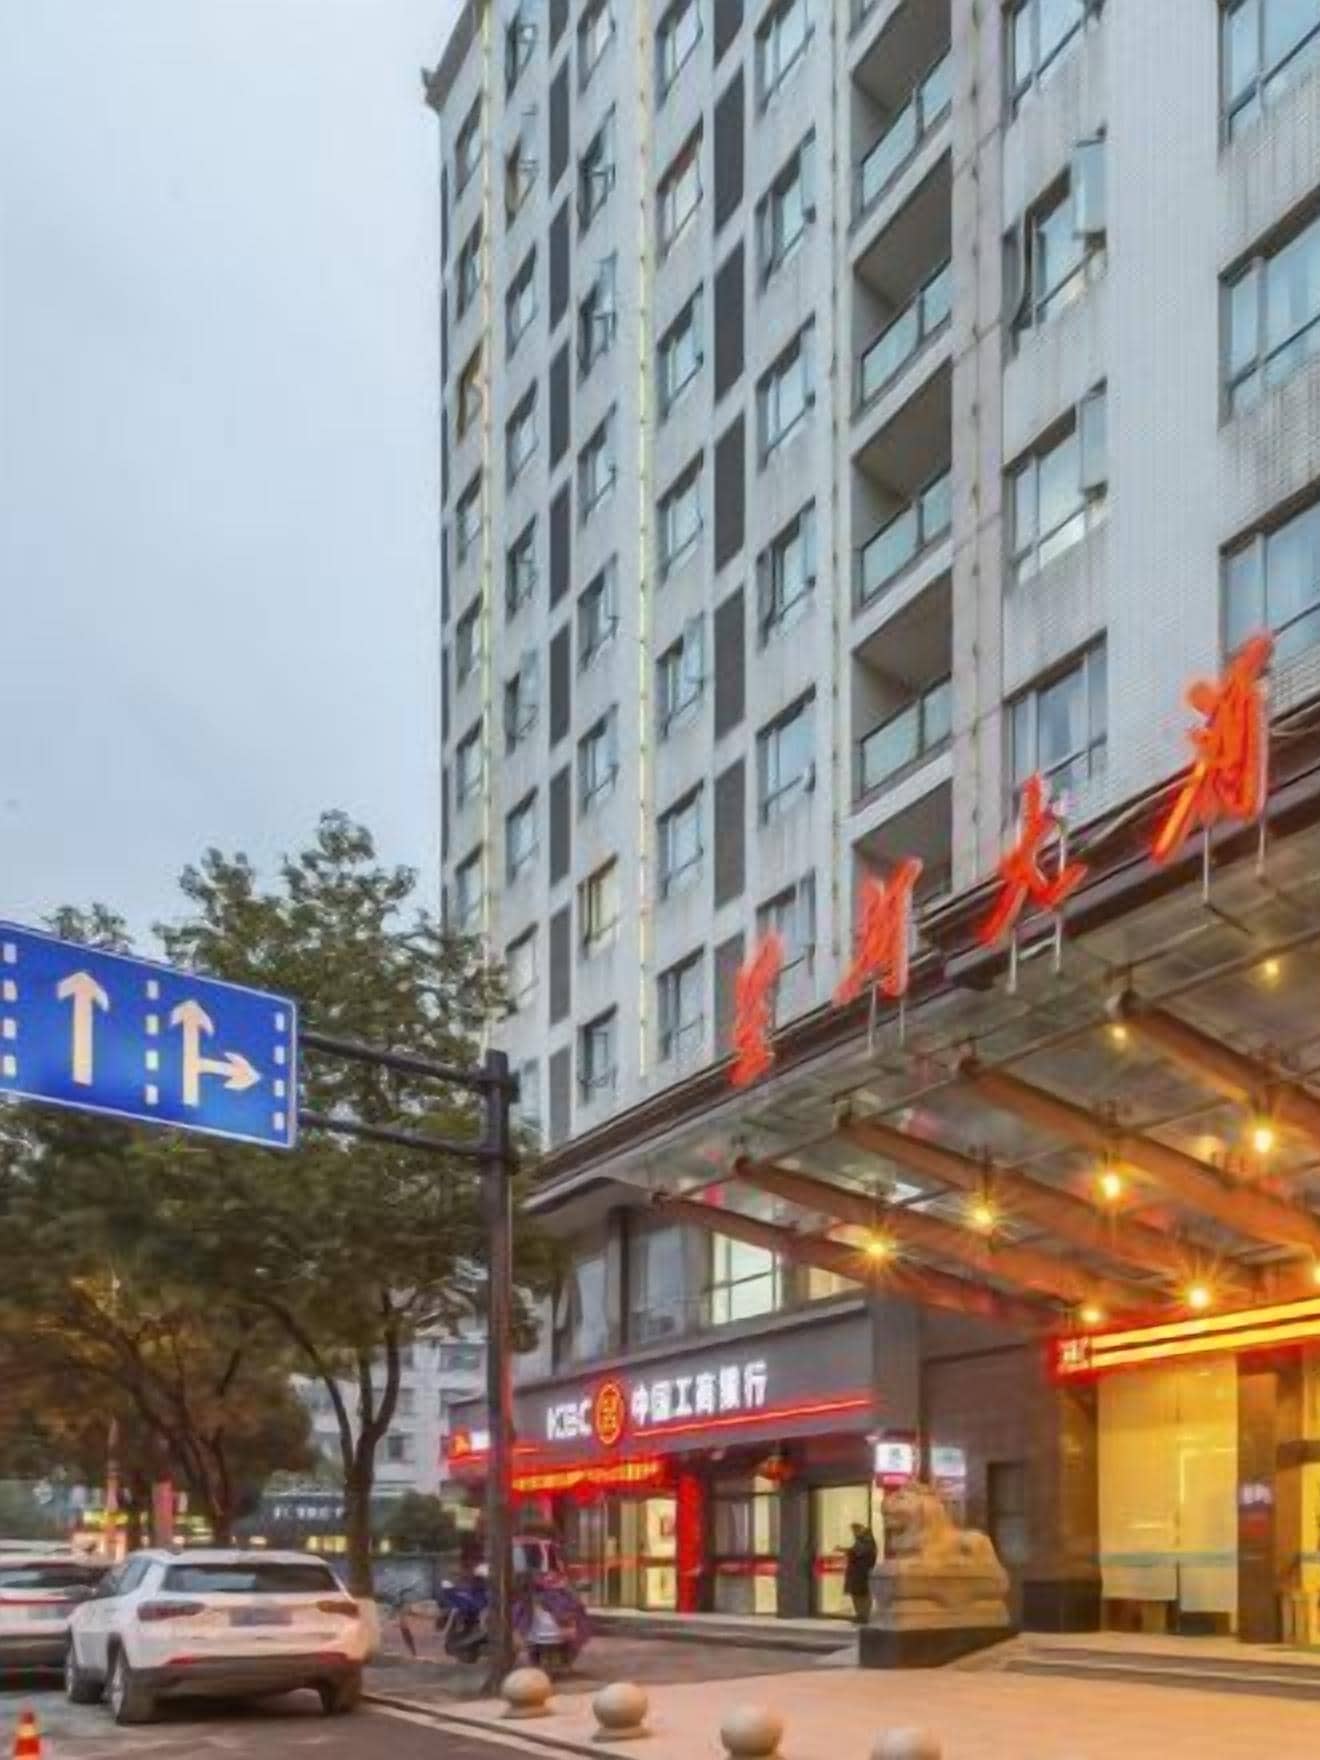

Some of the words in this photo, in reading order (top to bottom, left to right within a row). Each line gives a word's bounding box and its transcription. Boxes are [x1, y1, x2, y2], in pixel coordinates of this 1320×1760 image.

[631, 1359, 768, 1427] 中国工商银行
